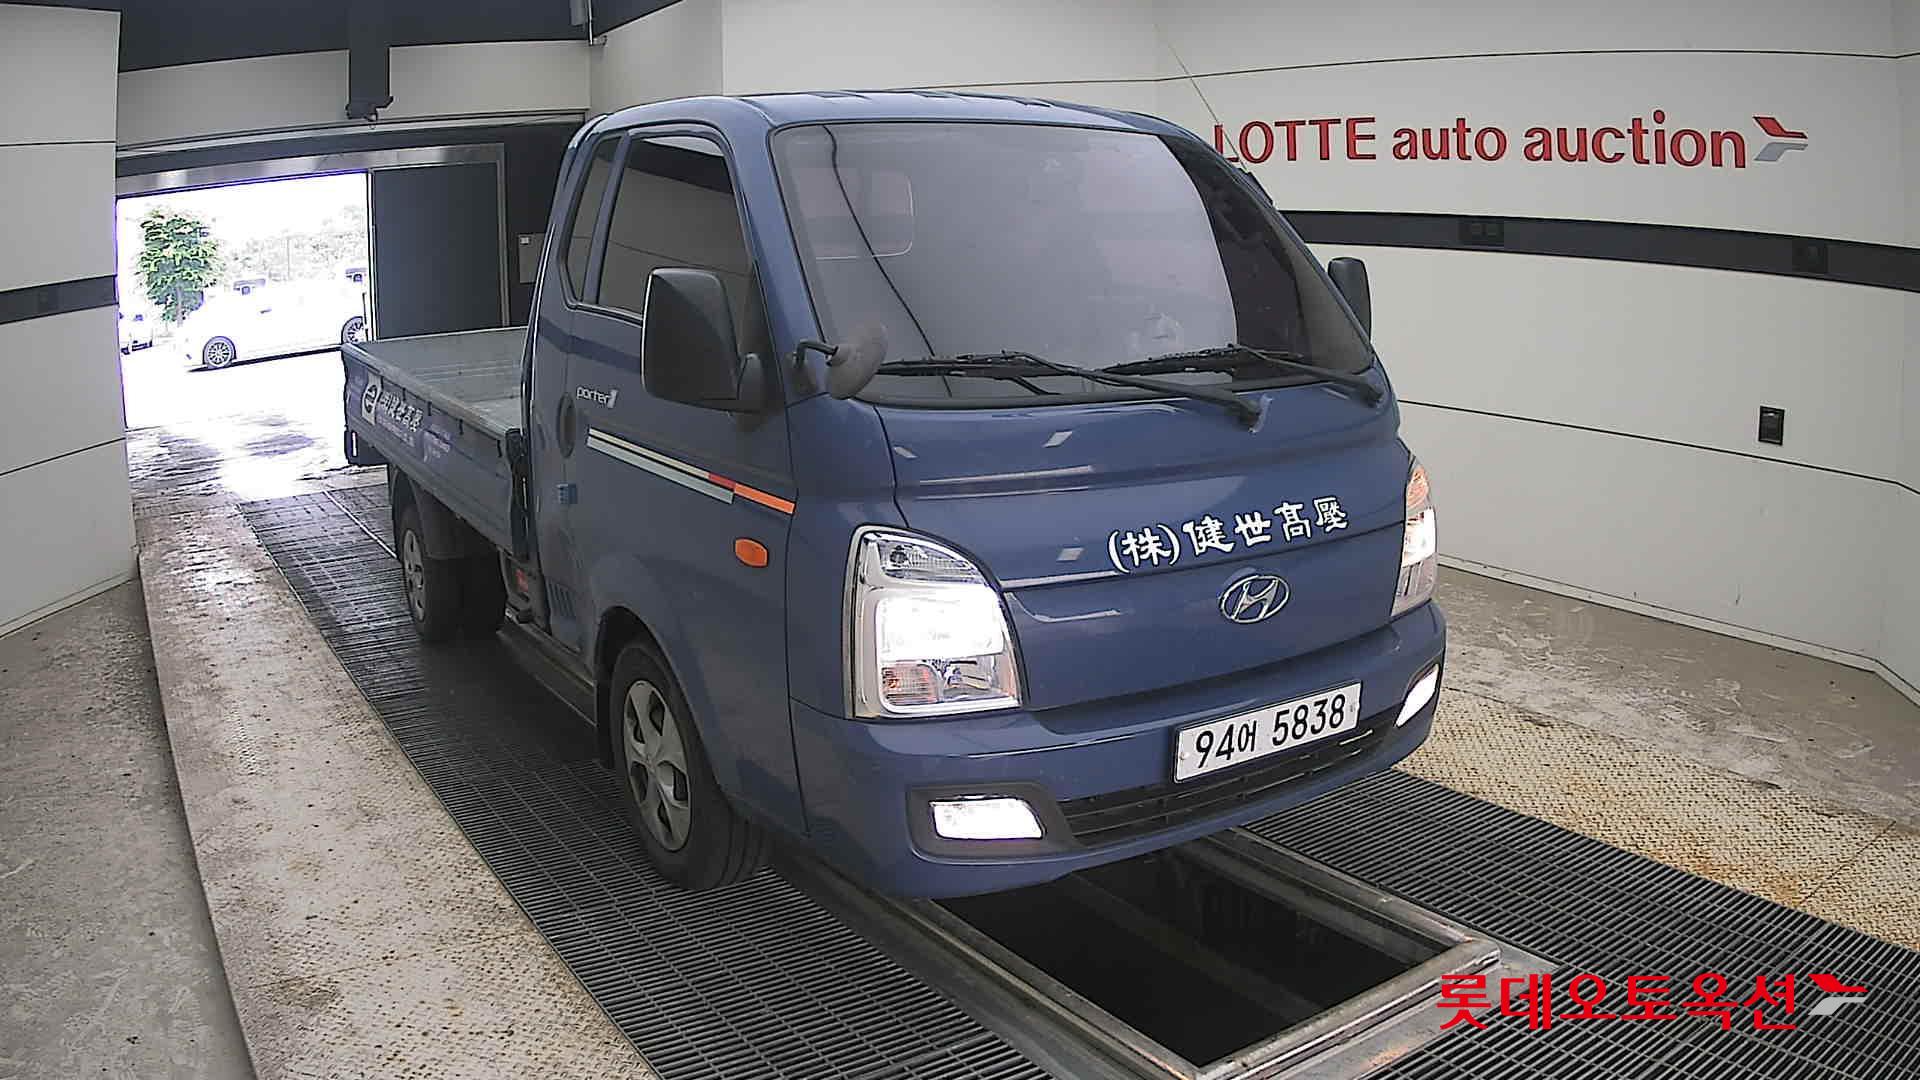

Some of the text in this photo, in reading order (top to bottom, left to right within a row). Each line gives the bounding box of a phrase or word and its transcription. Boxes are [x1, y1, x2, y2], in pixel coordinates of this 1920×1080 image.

[1214, 110, 1747, 169] LOTTE auto auction
[1195, 693, 1347, 769] 94어 5838
